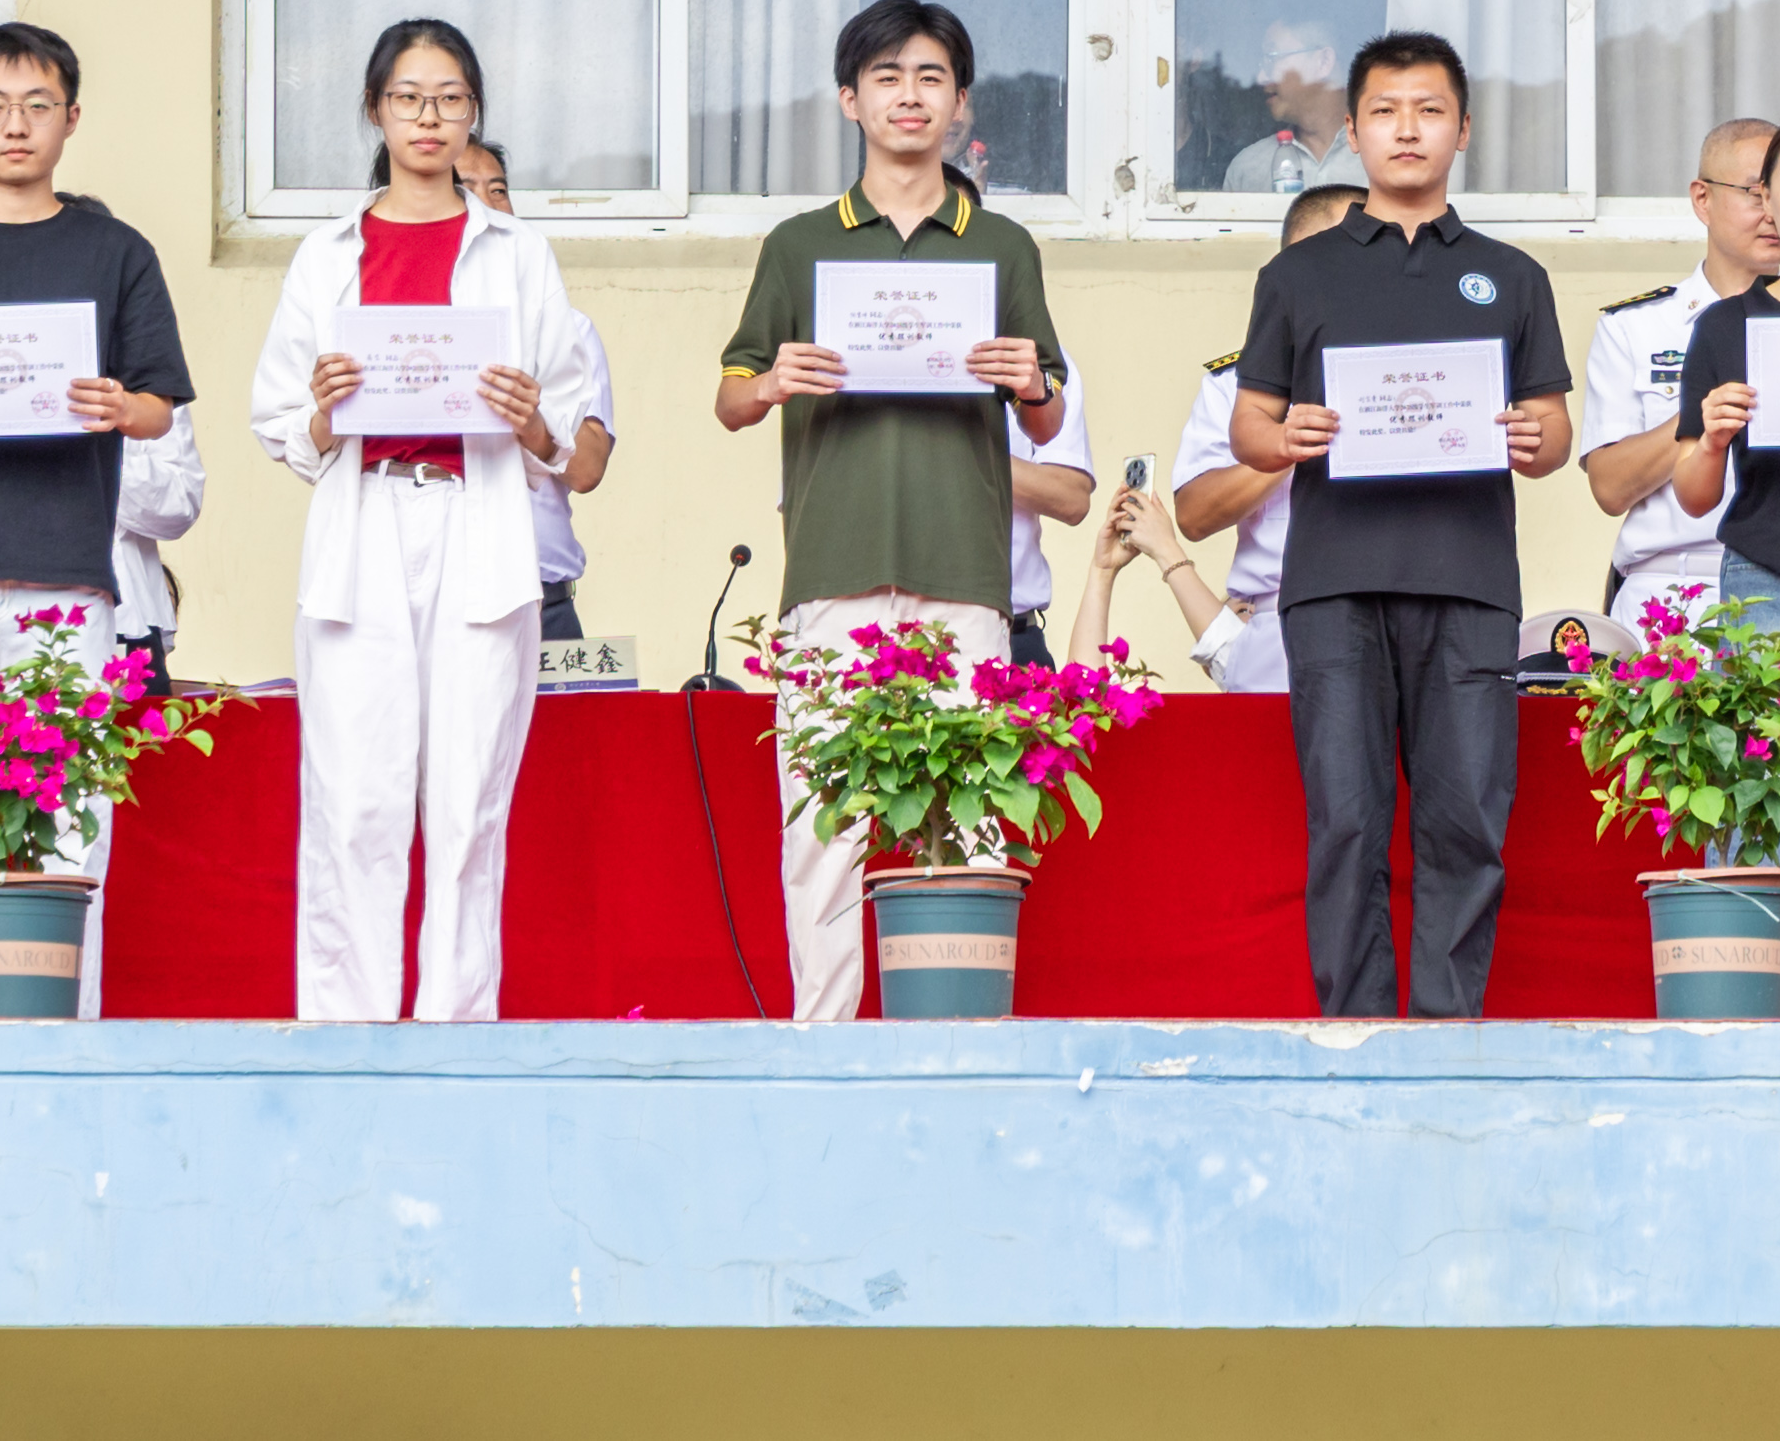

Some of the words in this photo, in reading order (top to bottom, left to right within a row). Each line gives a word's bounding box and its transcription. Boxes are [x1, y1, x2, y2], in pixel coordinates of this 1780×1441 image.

[873, 290, 938, 301] 荣誉证书
[389, 333, 453, 344] 荣誉证书
[1381, 371, 1446, 384] 荣誉证书
[538, 643, 623, 674] 王健鑫
[899, 943, 996, 961] SUNAROUD
